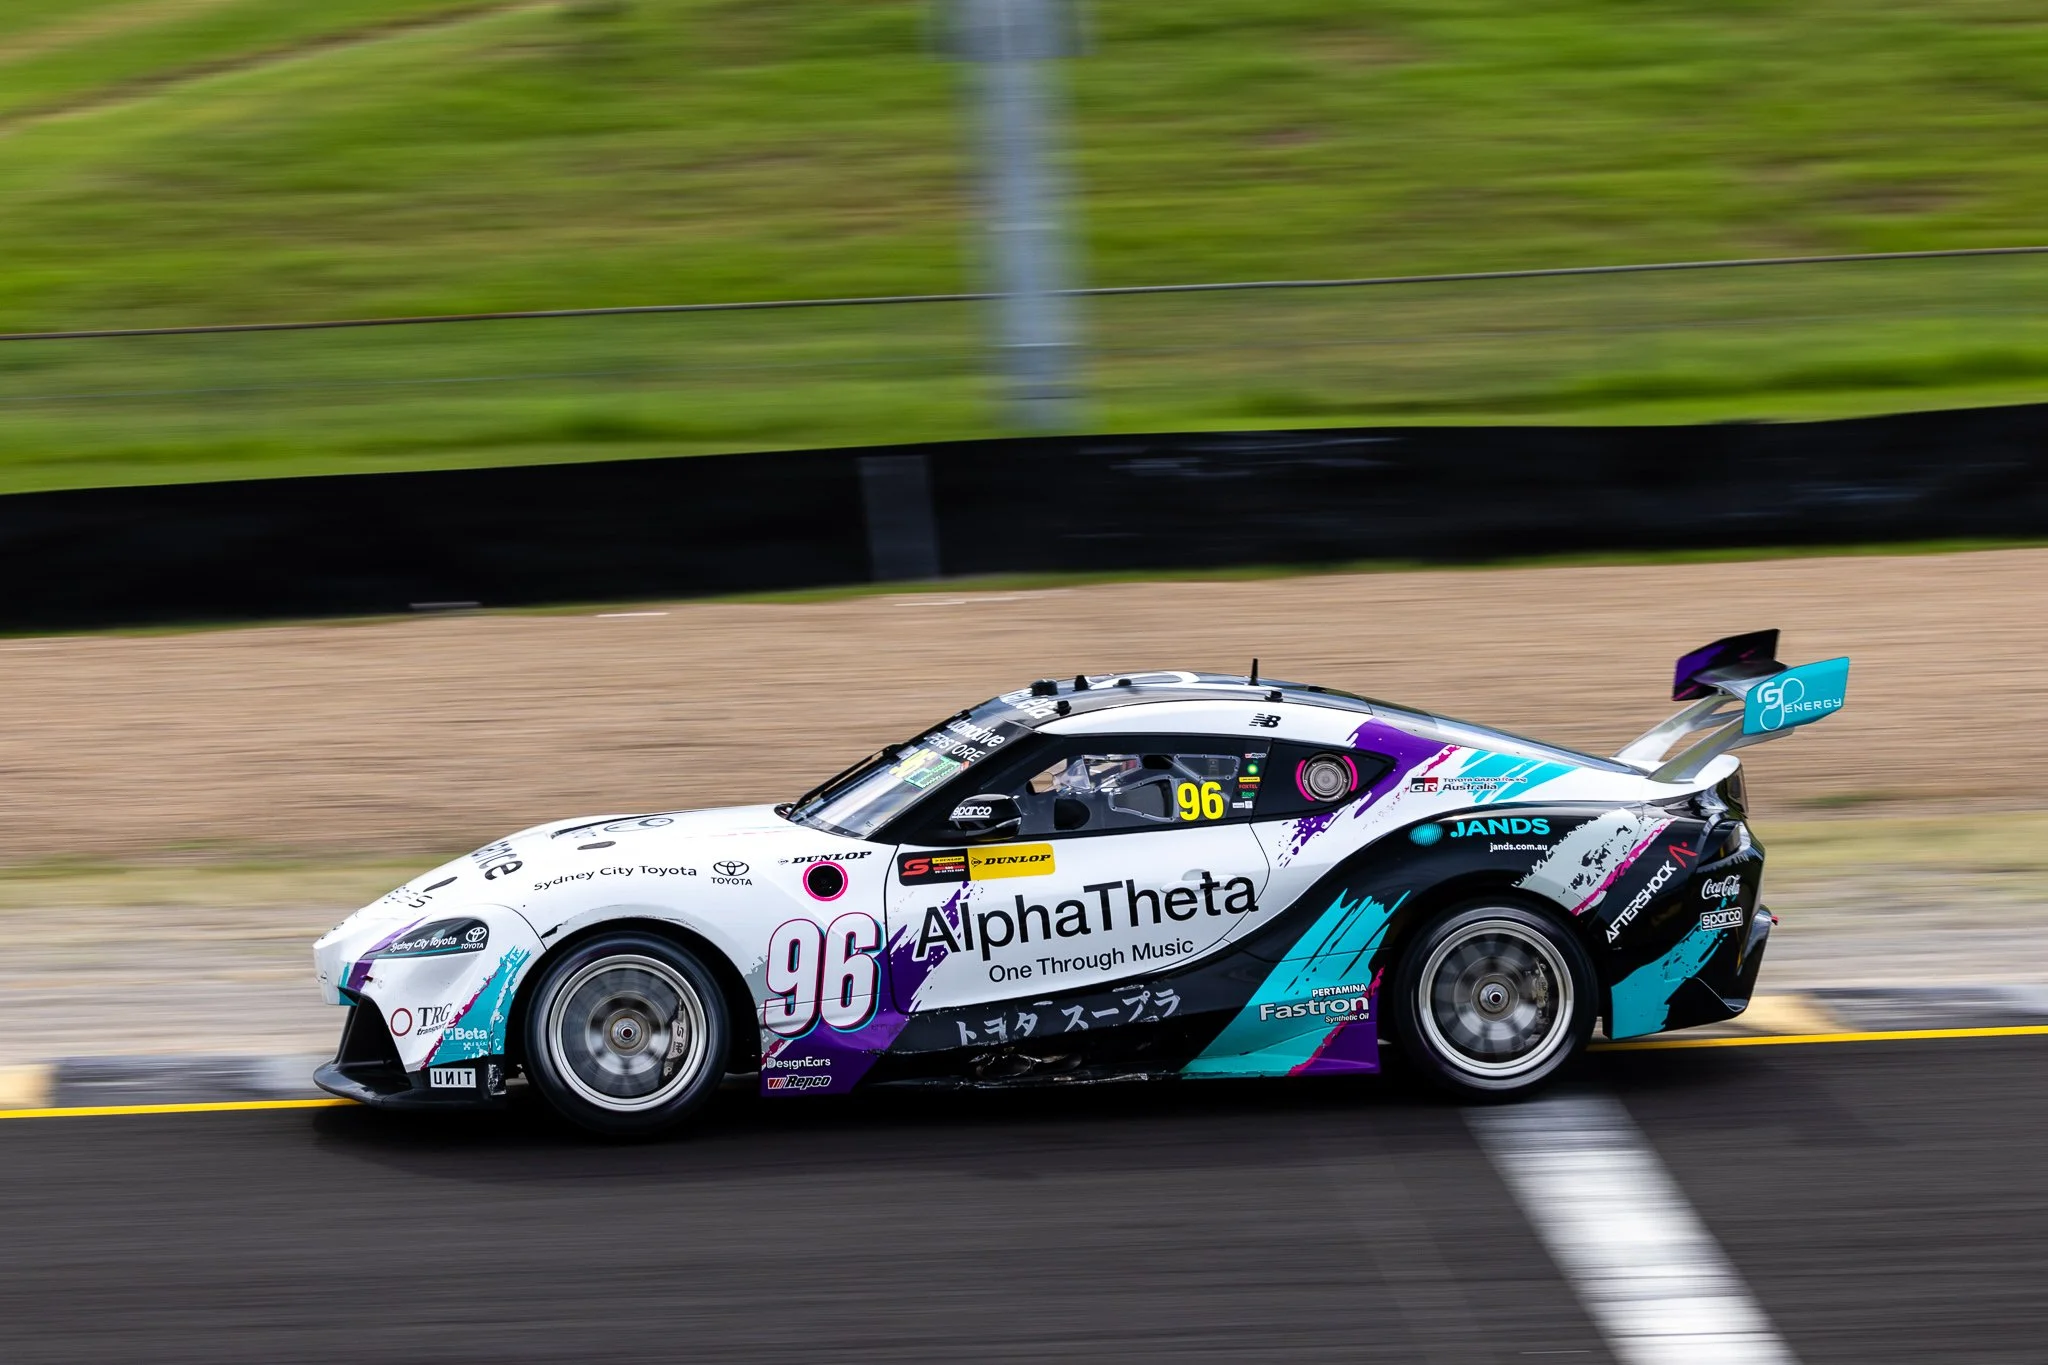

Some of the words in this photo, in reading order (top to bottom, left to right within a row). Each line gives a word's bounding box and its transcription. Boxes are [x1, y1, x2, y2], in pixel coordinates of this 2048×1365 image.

[1784, 698, 1842, 713] ENERGY
[1410, 782, 1438, 792] GR
[1442, 782, 1497, 791] Australia
[1177, 781, 1224, 821] 96
[953, 806, 992, 818] sparco
[1450, 818, 1550, 838] JANDS
[1489, 842, 1548, 852] jands.com.au
[791, 850, 873, 865] DUNLOP
[984, 854, 1051, 865] DUNLOP
[534, 870, 595, 891] Sydney
[600, 866, 635, 880] City
[638, 865, 698, 878] Toyota
[711, 876, 753, 886] TOYOTA
[1605, 860, 1677, 944] AFTERSHOCK
[913, 872, 1259, 964] AlphaTheta
[1702, 909, 1742, 926] sparco
[390, 942, 415, 953] Sydney
[414, 938, 429, 950] City
[430, 936, 457, 948] Toyota
[988, 964, 1032, 984] One
[1036, 946, 1126, 980] Through
[1131, 937, 1194, 961] Music
[764, 911, 882, 1039] 96
[1312, 983, 1367, 998] PERTAMINA
[417, 1003, 453, 1027] TRG
[1260, 996, 1369, 1021] Fastron
[1325, 1015, 1358, 1023] Synthetic
[1359, 1012, 1369, 1020] Oil
[454, 1027, 488, 1040] Beta
[766, 1056, 831, 1070] DesignEars
[783, 1074, 832, 1091] Repco
